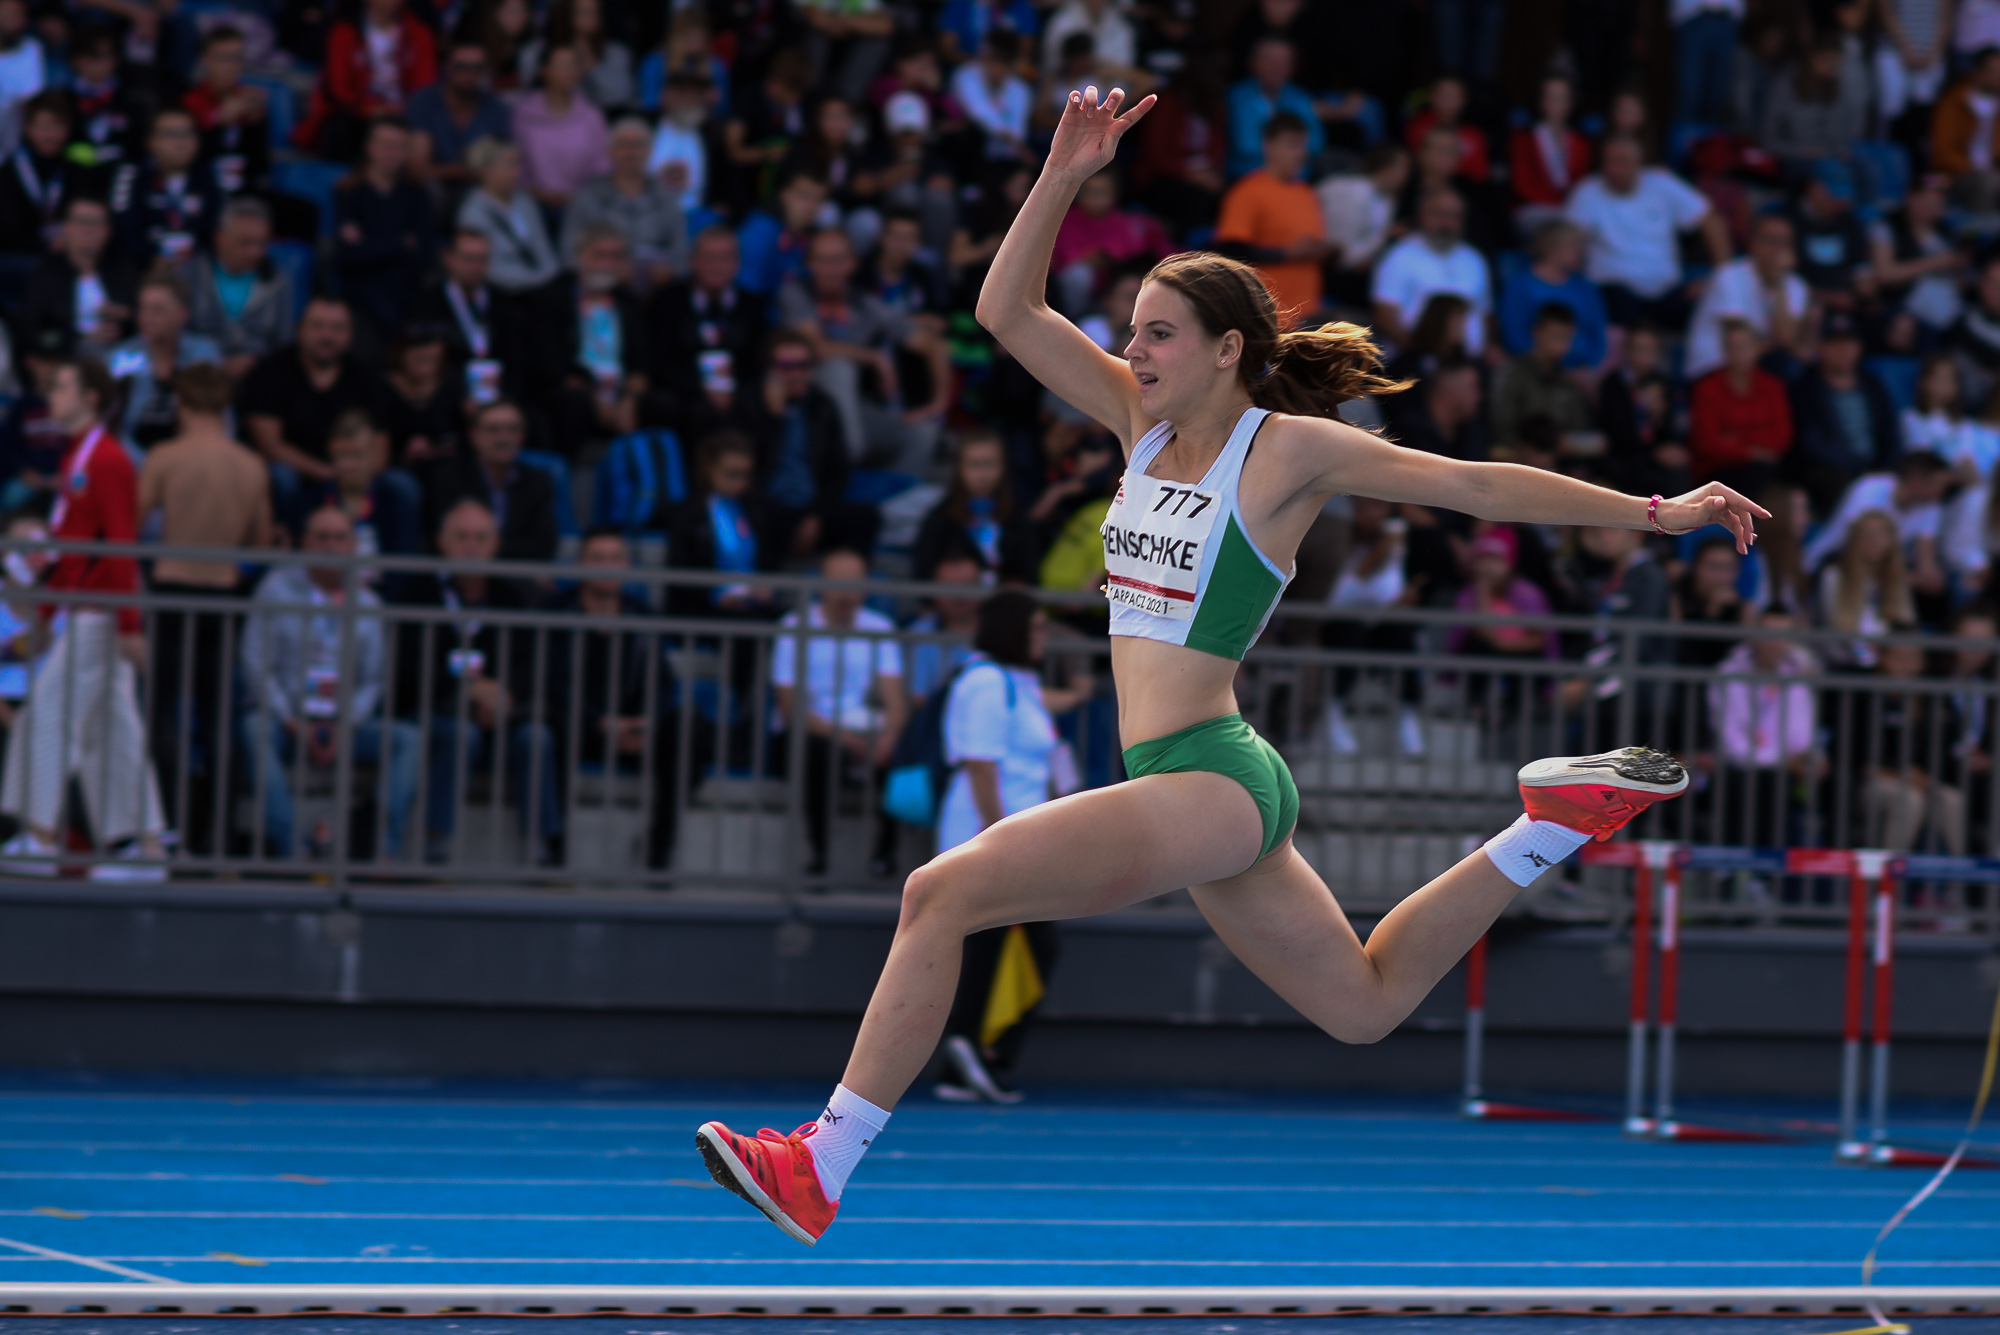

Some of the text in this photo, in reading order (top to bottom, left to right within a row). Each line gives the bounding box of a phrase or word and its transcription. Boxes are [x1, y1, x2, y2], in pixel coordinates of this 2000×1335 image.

[1152, 486, 1212, 519] 777
[1101, 523, 1198, 571] HENSCHKE
[1110, 586, 1146, 609] ARPACZ
[1146, 597, 1169, 615] 2021
